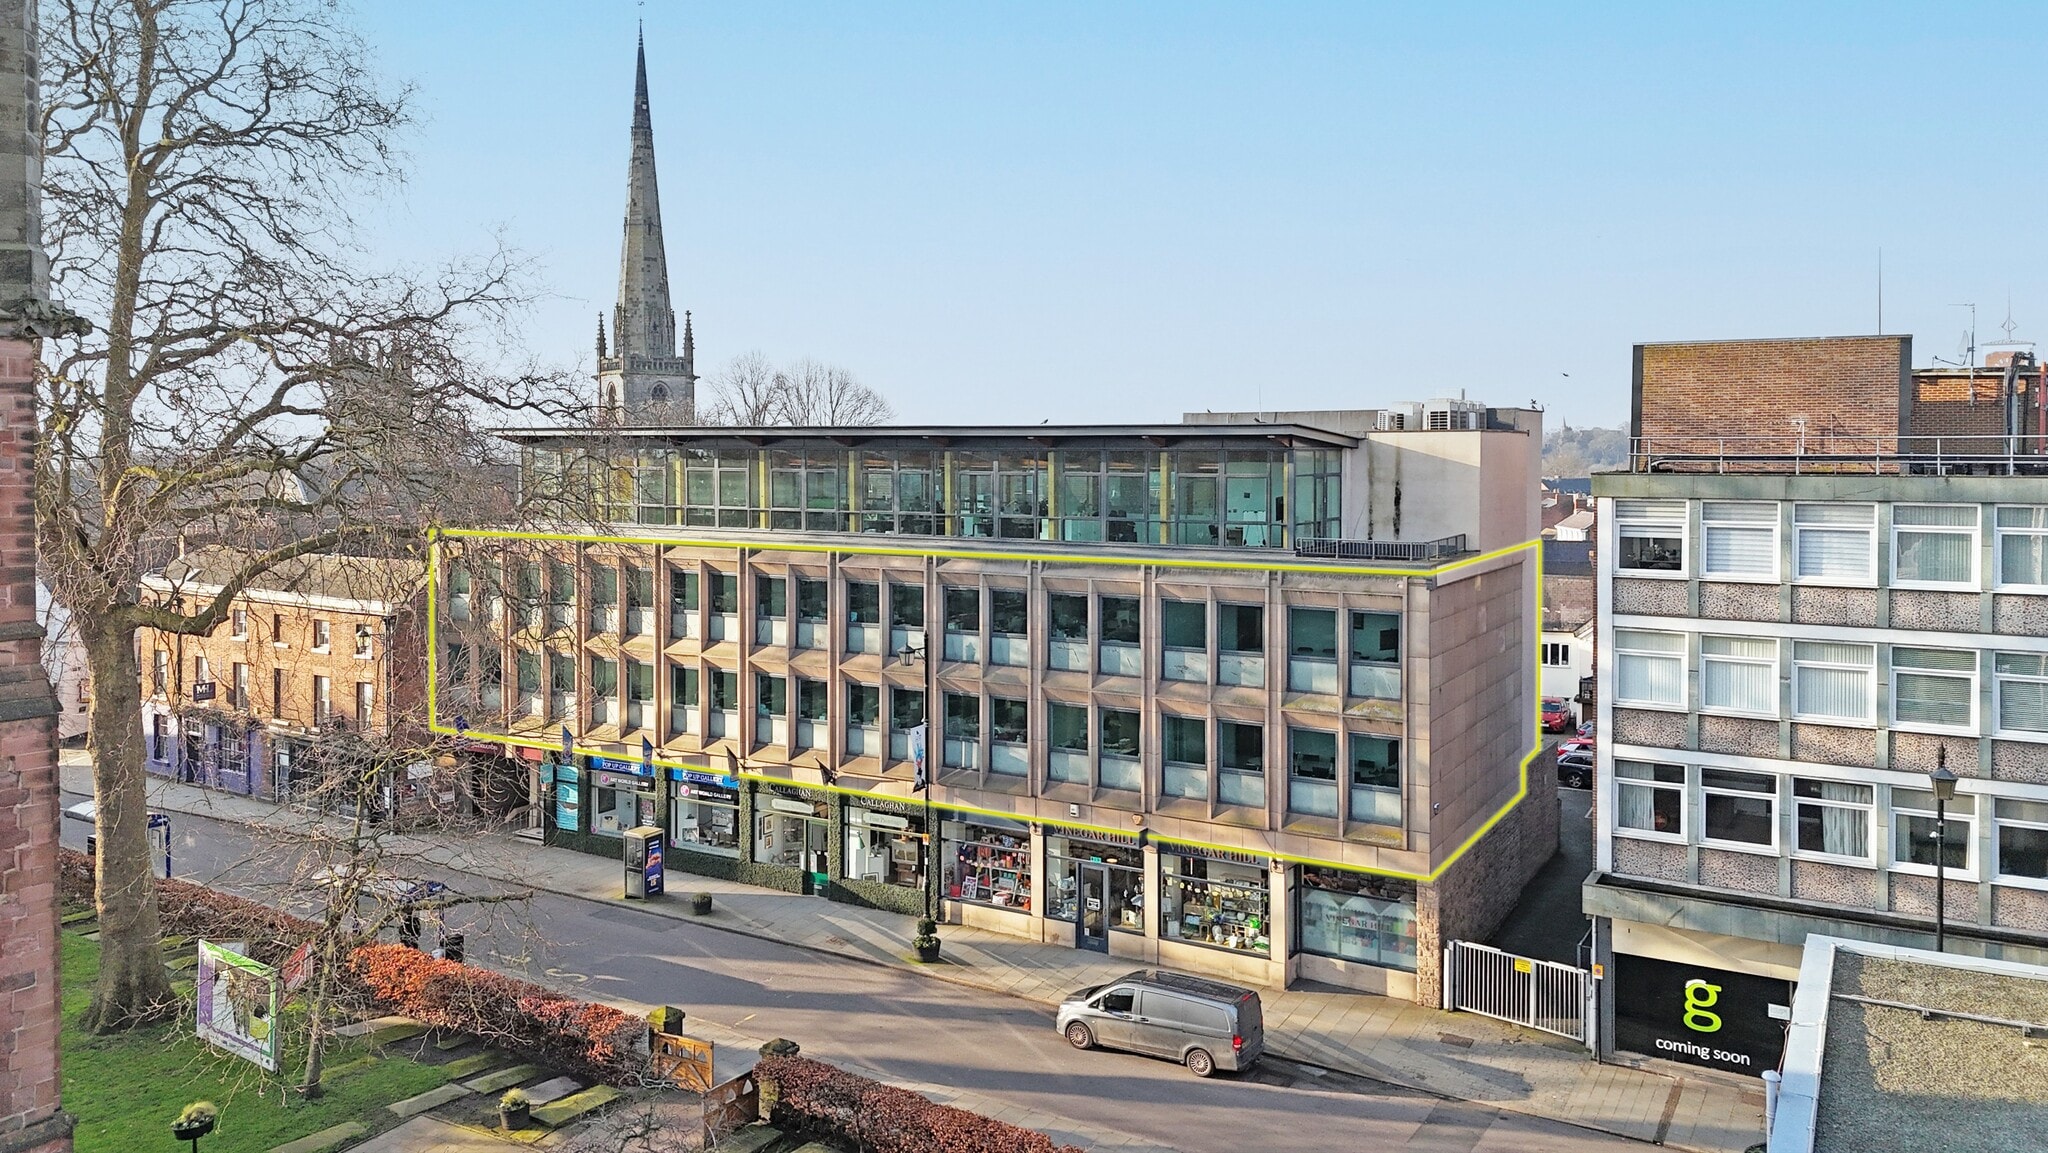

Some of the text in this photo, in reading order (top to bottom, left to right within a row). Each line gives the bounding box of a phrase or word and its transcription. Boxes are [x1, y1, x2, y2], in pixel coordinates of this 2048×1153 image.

[769, 782, 811, 798] CALLAGHAN
[860, 796, 905, 811] CALLAGHAN
[1053, 824, 1137, 845] VINEGAR HILL
[1168, 842, 1260, 864] VINEGAR HILL
[1683, 979, 1722, 1032] g
[1655, 1038, 1751, 1066] coming soon
